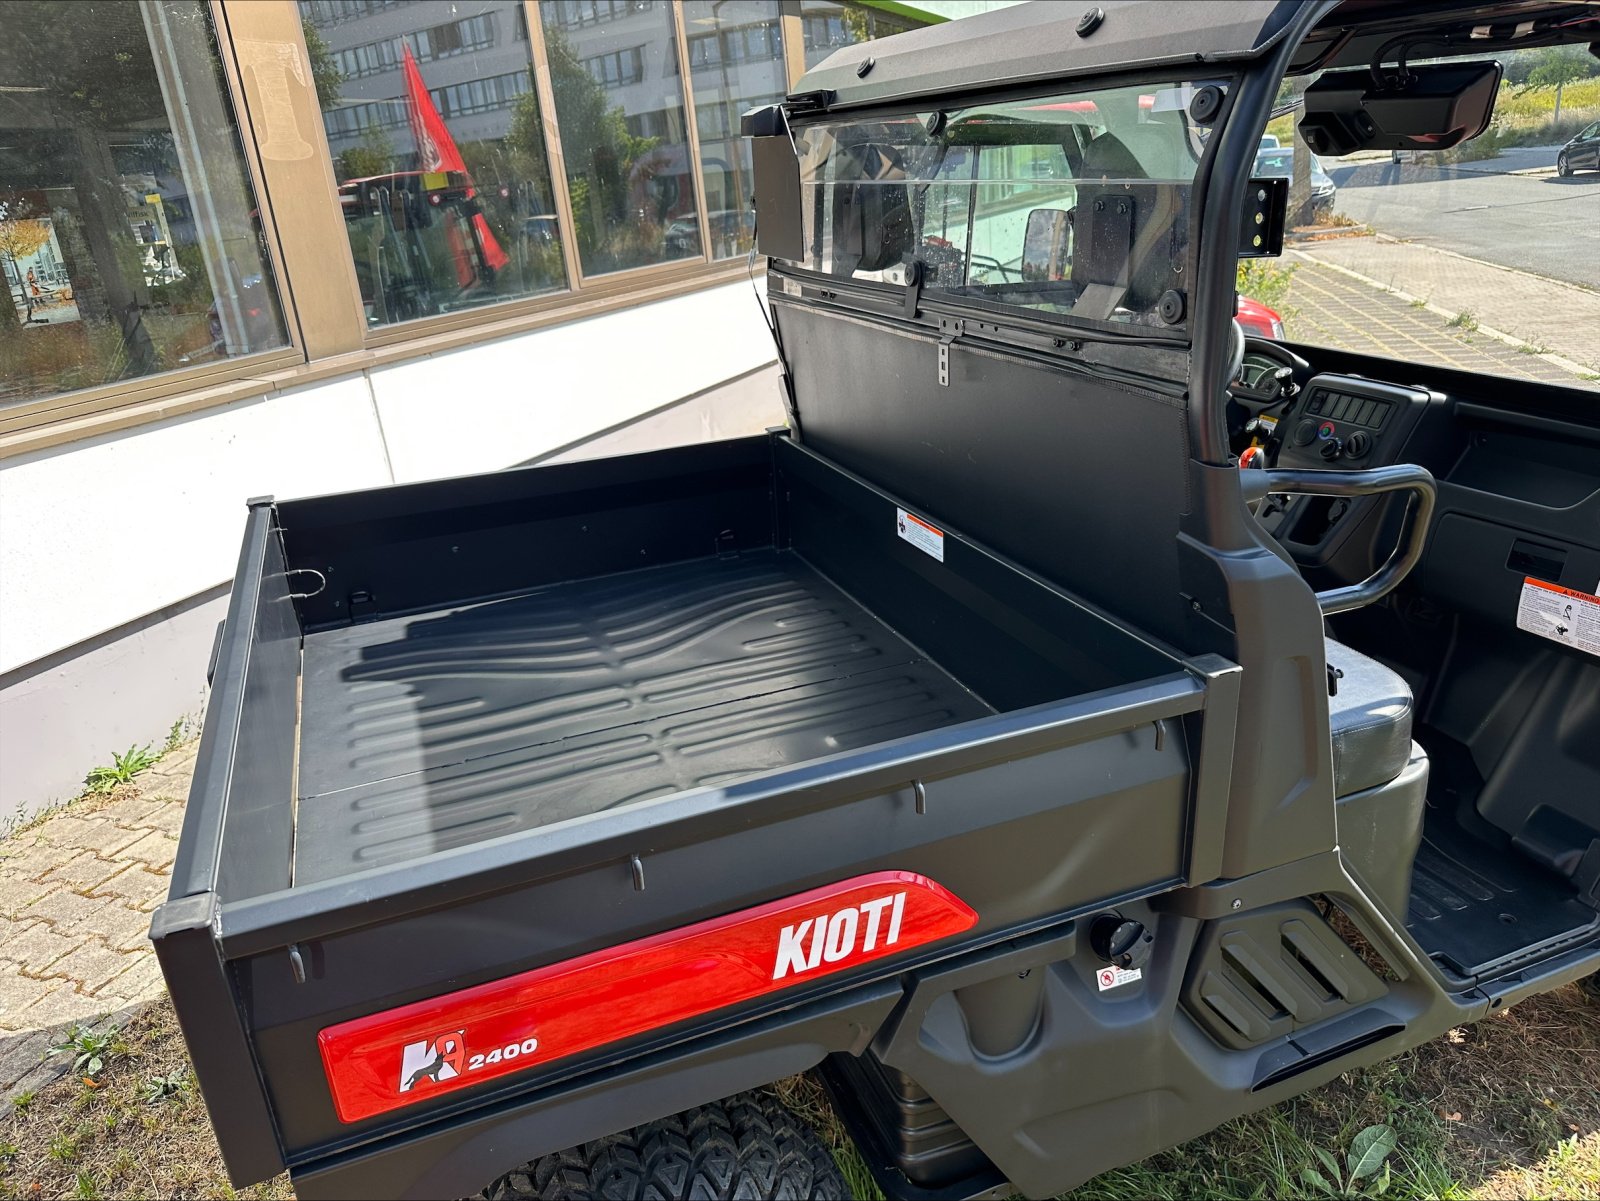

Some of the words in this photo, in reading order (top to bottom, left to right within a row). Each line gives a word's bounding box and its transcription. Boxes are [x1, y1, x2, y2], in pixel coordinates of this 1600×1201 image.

[1570, 591, 1600, 603] WARNING
[772, 892, 907, 980] KIOTI
[399, 1029, 467, 1093] K9
[468, 1038, 538, 1071] 2400
